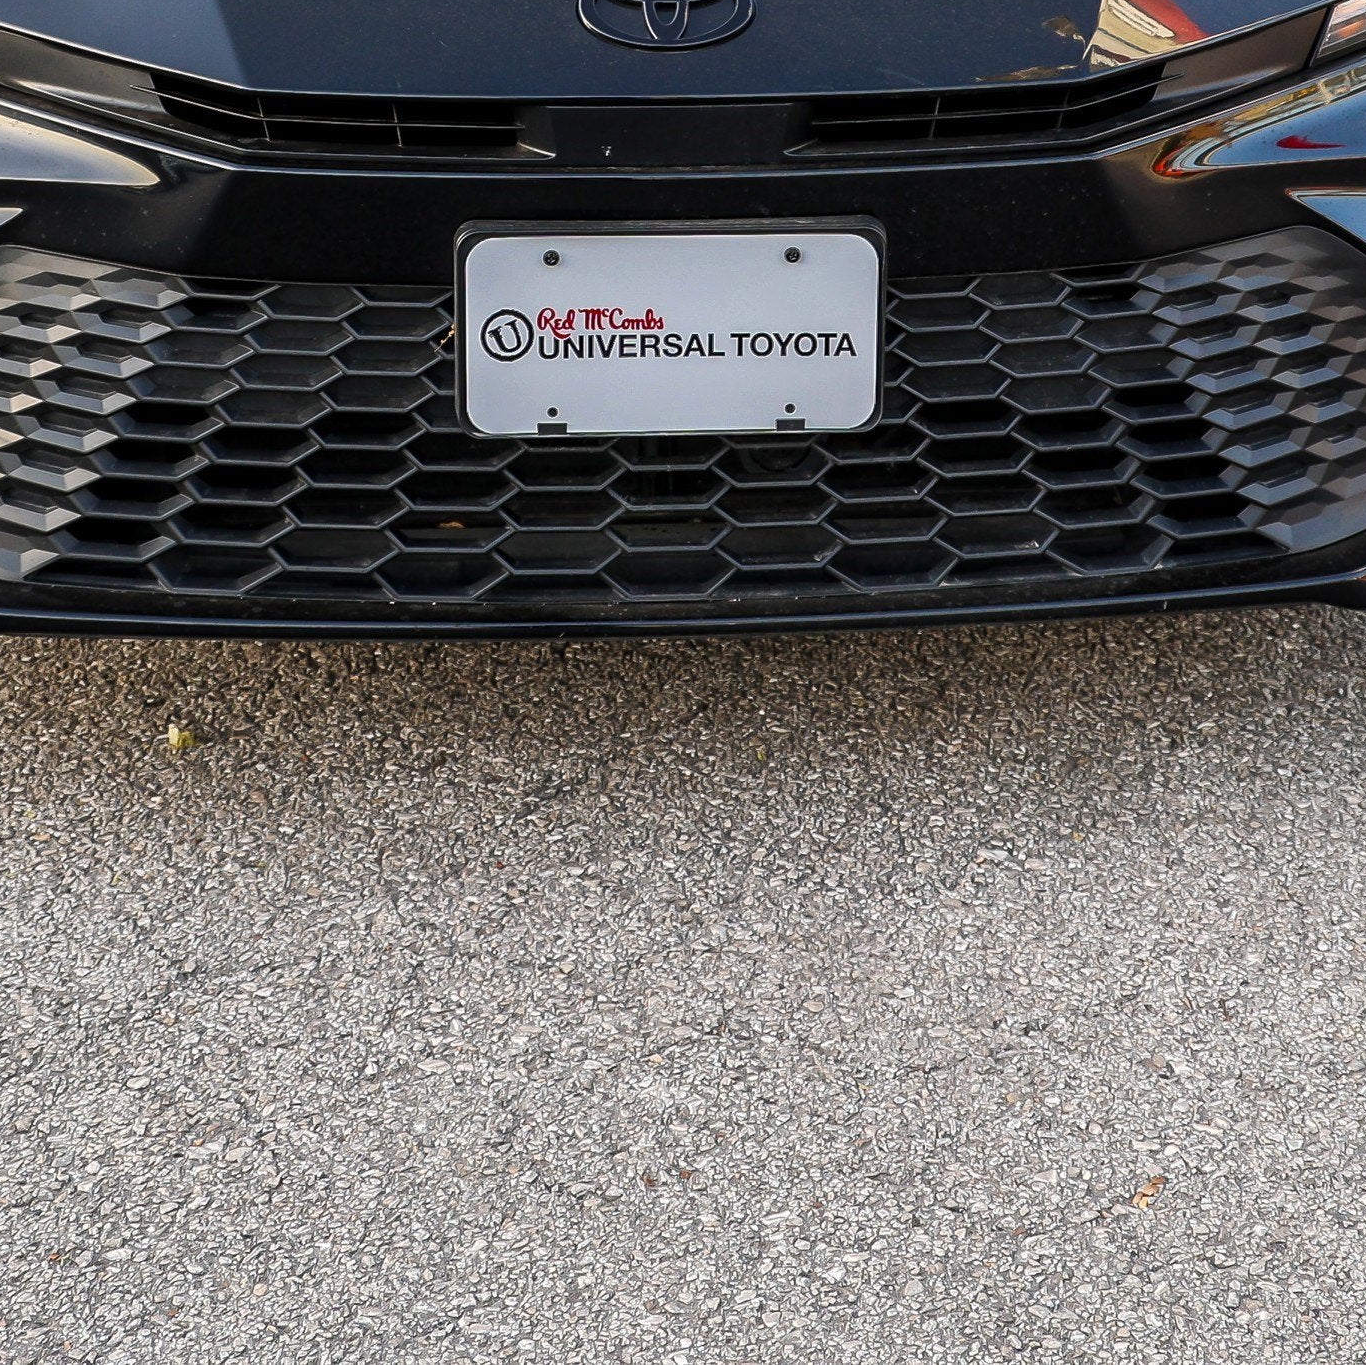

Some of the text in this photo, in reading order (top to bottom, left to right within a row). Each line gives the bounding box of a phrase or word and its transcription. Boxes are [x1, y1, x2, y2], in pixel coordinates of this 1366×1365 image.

[537, 307, 664, 339] Red McCombs
[538, 331, 858, 360] UNIVERSAL TOYOTA
